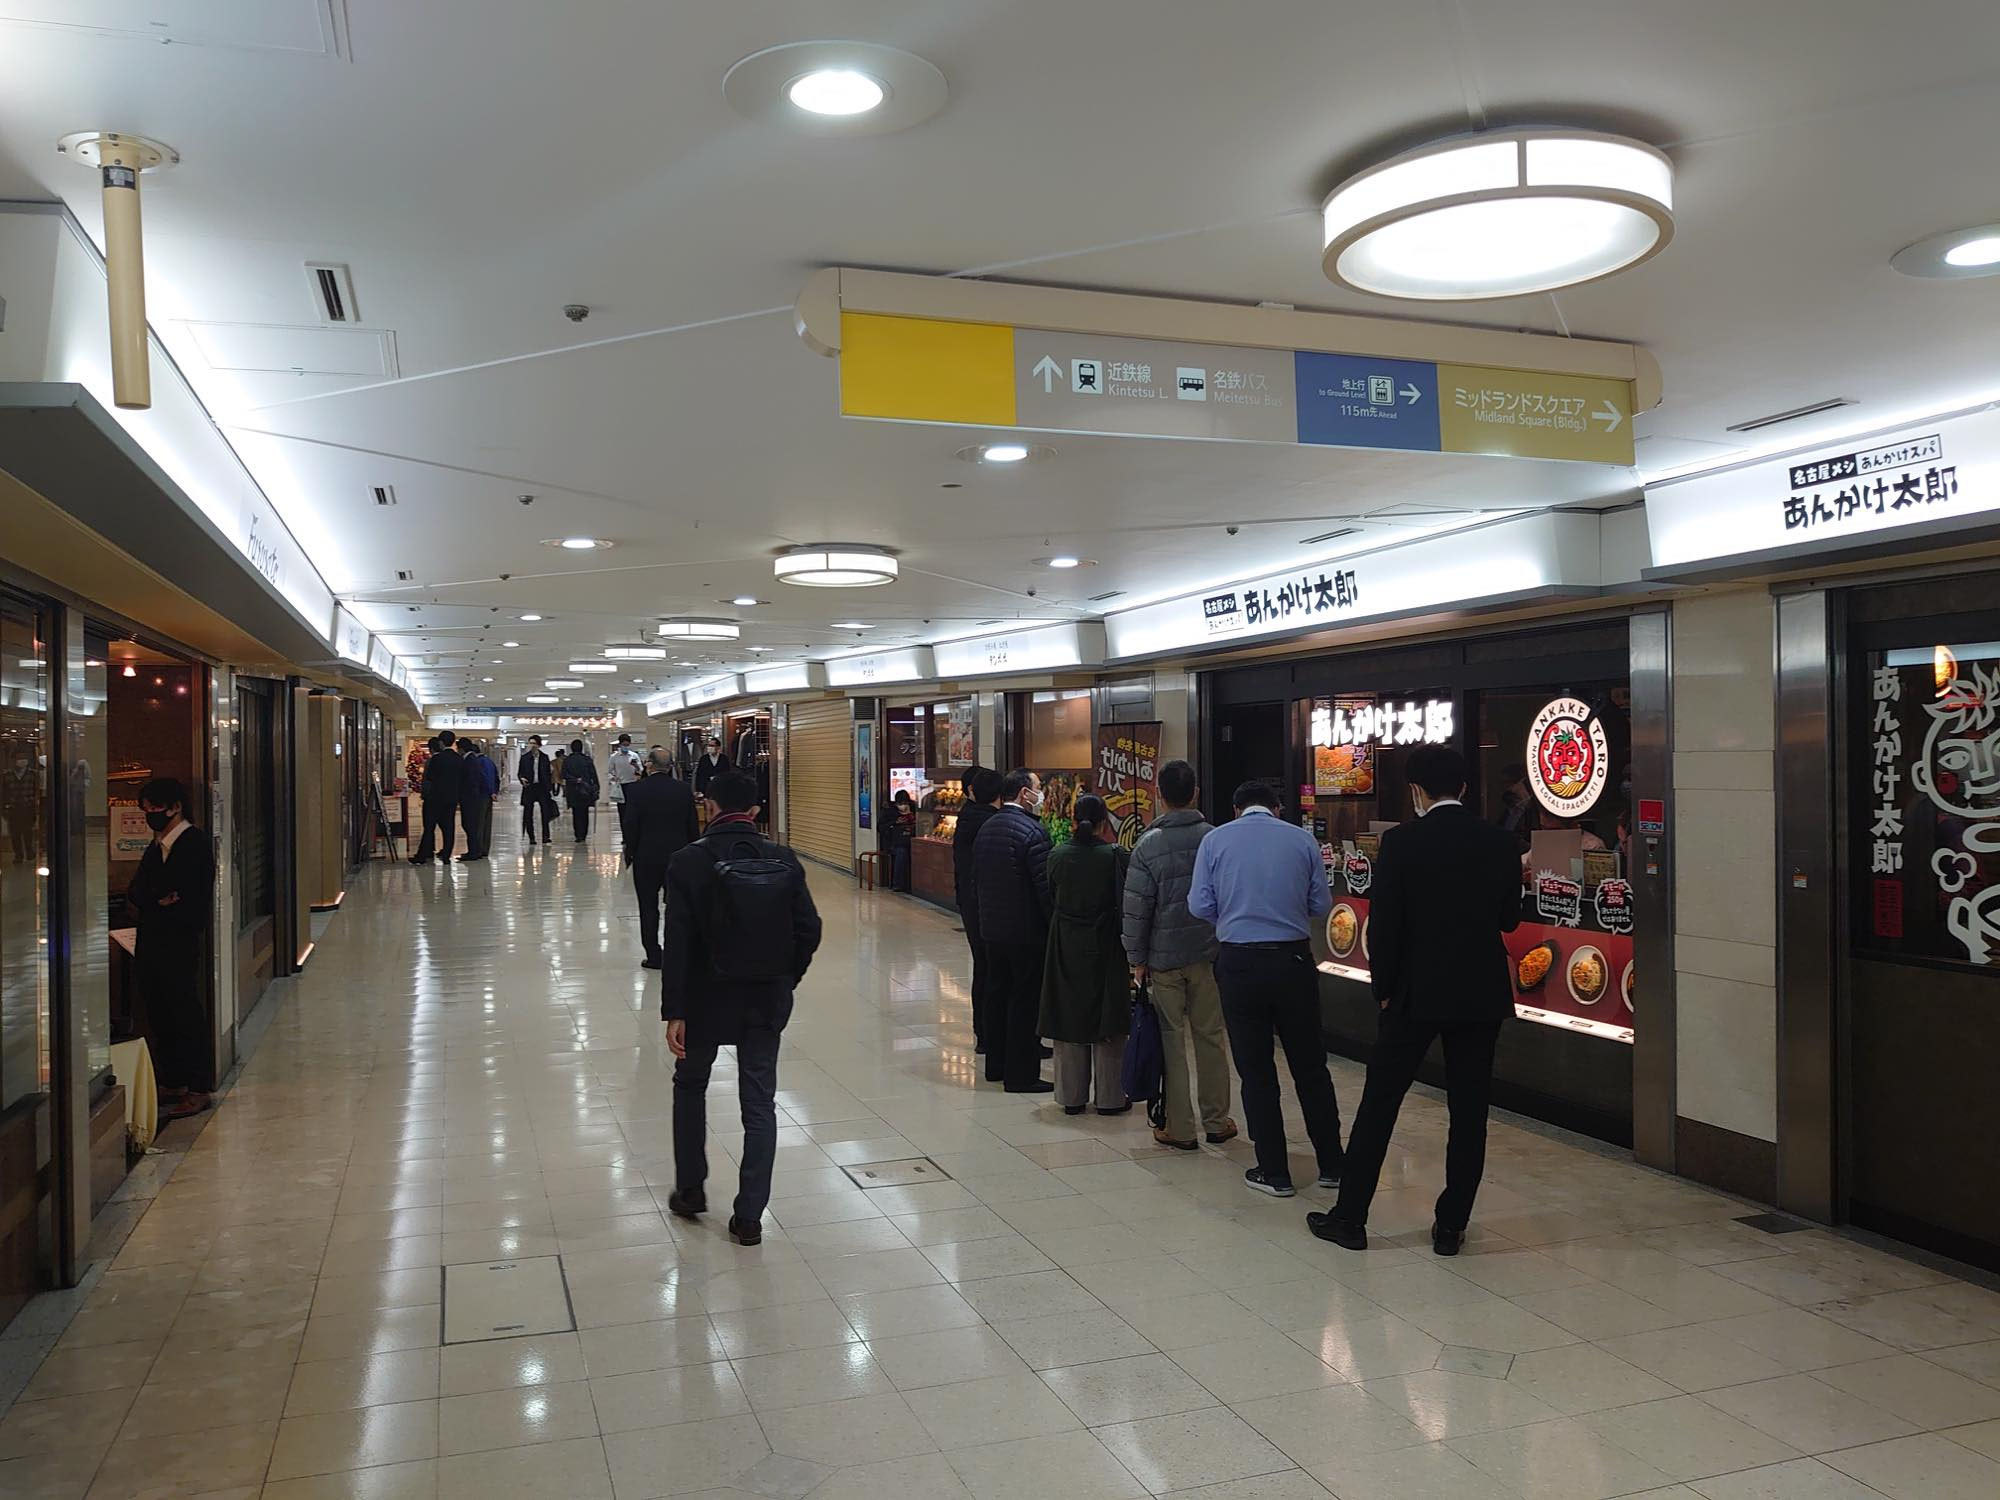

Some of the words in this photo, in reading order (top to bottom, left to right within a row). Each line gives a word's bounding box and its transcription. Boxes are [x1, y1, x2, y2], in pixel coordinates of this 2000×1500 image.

[1107, 361, 1152, 384] 近鉄線
[1214, 370, 1268, 391] 名鉄バス
[1108, 384, 1155, 399] Kintetsu
[1215, 391, 1260, 406] Meitetsu
[1264, 395, 1283, 407] Bus
[1327, 389, 1348, 398] Ground
[1350, 390, 1366, 399] Level
[1455, 387, 1586, 416] ミッドランドスクエア
[1475, 410, 1515, 425] Midland
[1519, 413, 1551, 428] Square
[1553, 416, 1587, 432] (Bldg.)
[1861, 441, 1936, 470] あんかけスパ
[1795, 460, 1855, 485] 名古屋メシ
[1783, 466, 1958, 530] あんかけ太郎
[1204, 598, 1235, 614] 名古屋メシ
[1244, 570, 1358, 625] あんかけ太郎
[1311, 700, 1453, 748] あんかけ太郎
[1534, 702, 1585, 739] ANKAKE
[1592, 725, 1606, 778] TARO
[1532, 745, 1541, 786] NAGOYA
[1540, 787, 1560, 809] LOCAL
[1561, 781, 1599, 810] SPAGHETTI
[1870, 665, 1904, 874] あんかけ太郎
